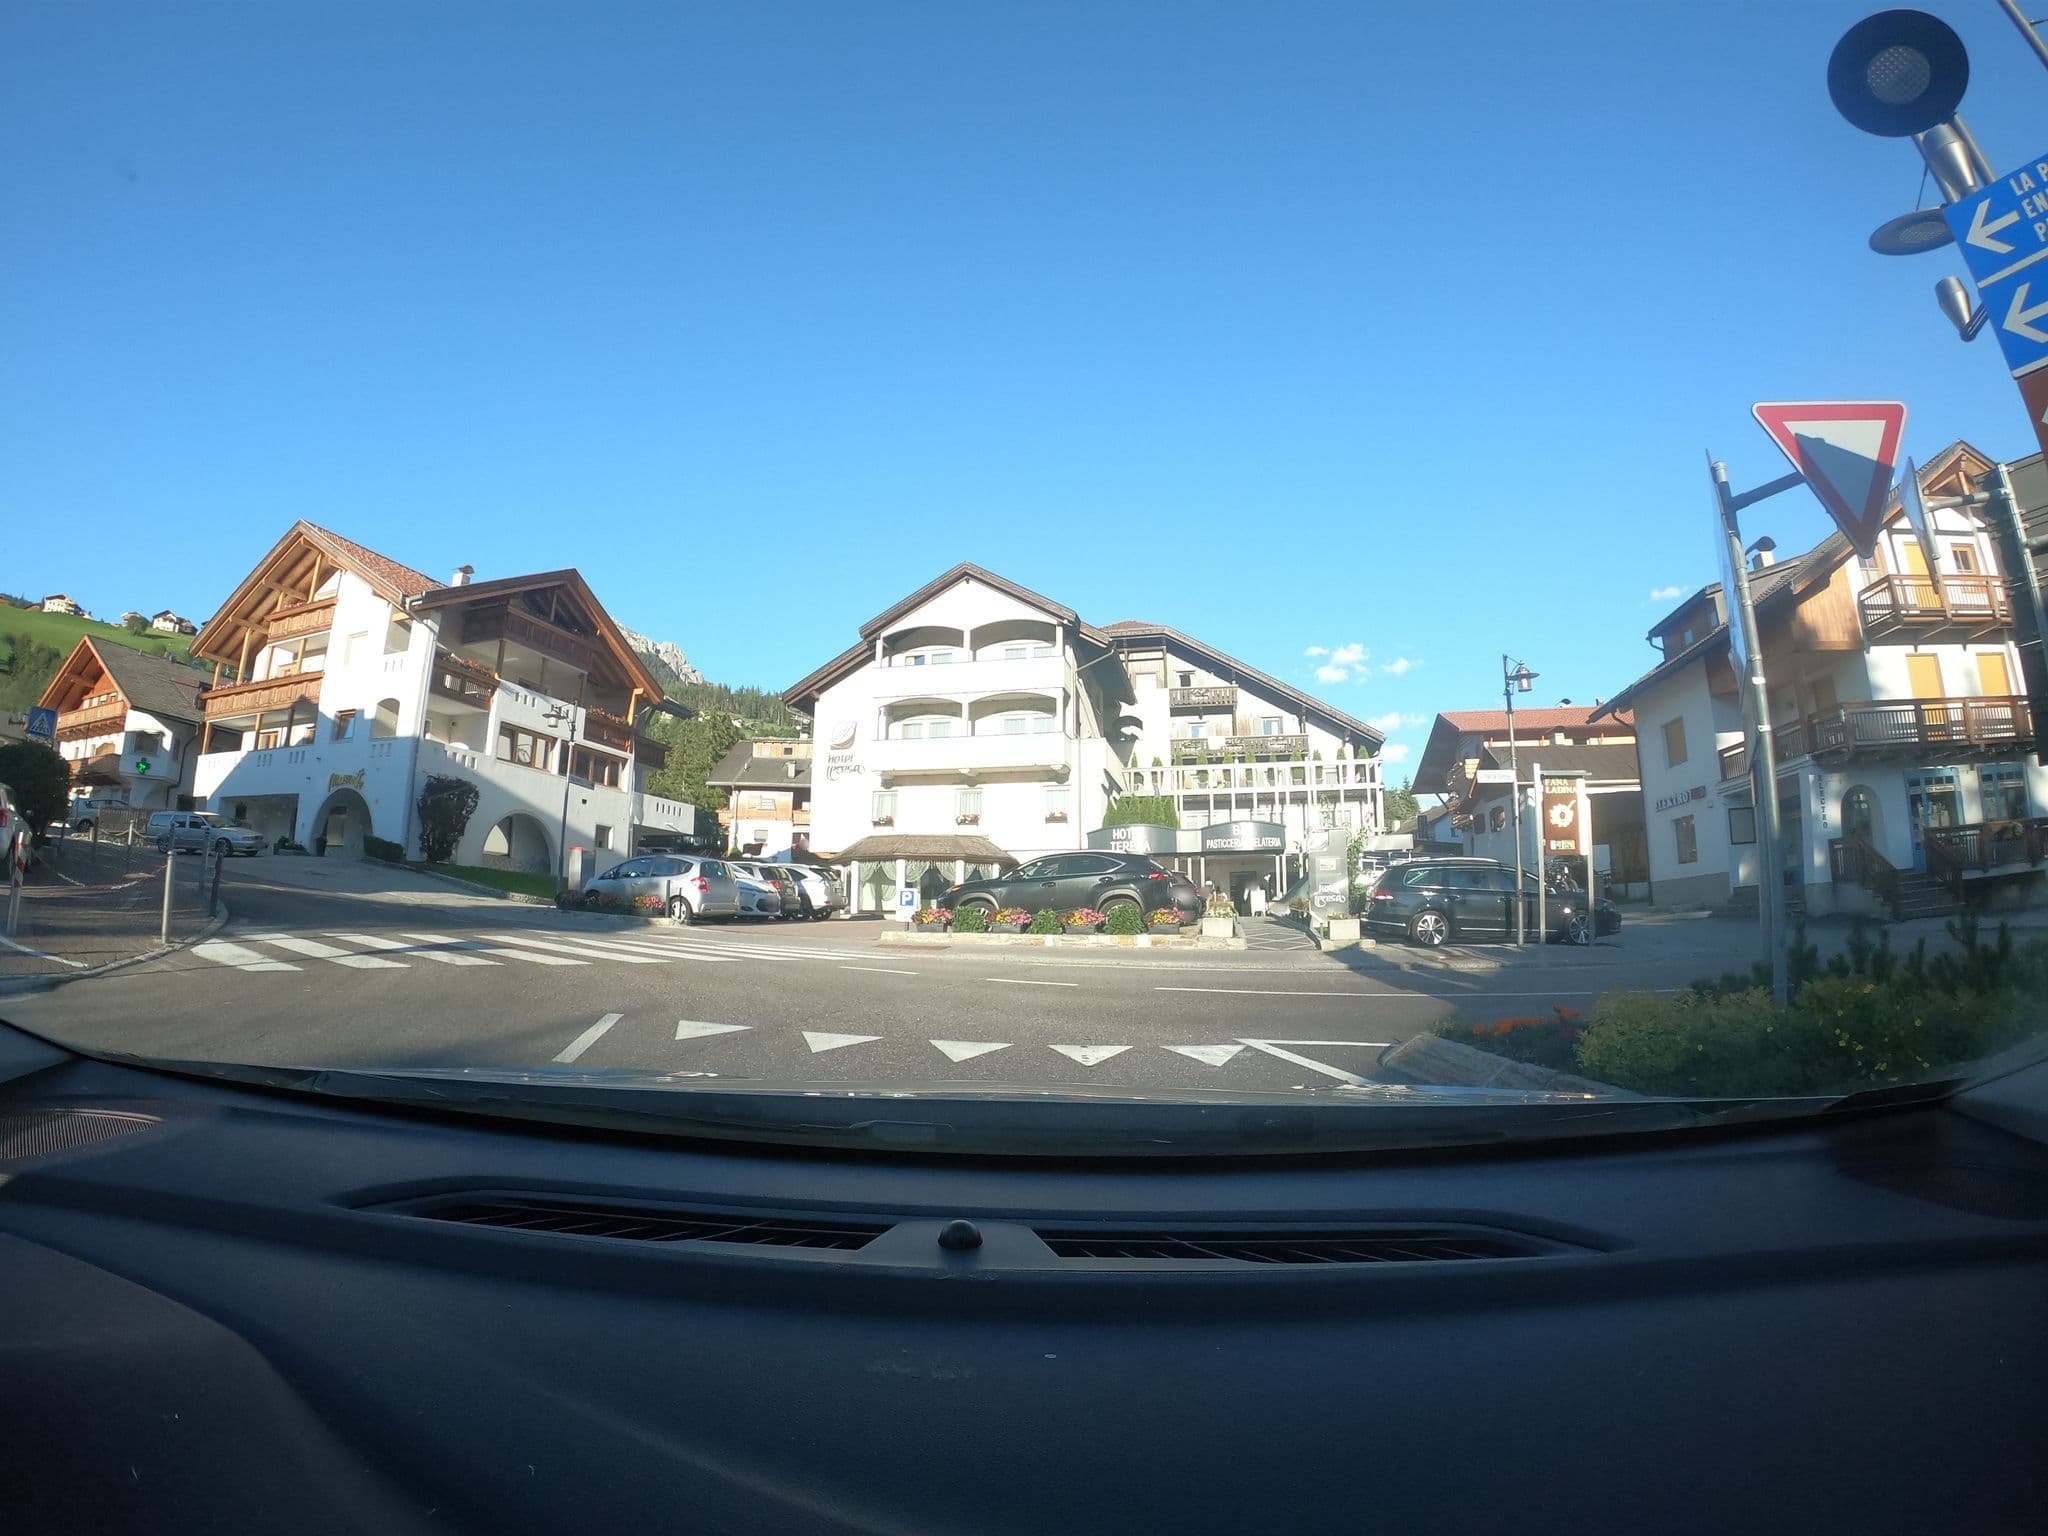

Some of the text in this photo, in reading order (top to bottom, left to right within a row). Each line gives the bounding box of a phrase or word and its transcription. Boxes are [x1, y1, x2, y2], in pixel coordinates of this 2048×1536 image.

[2009, 172, 2036, 196] LA
[2021, 188, 2048, 219] EN
[1112, 828, 1142, 840] HOT
[1110, 840, 1151, 852] TERA
[1206, 837, 1282, 849] PASTICCERI ELATERIA
